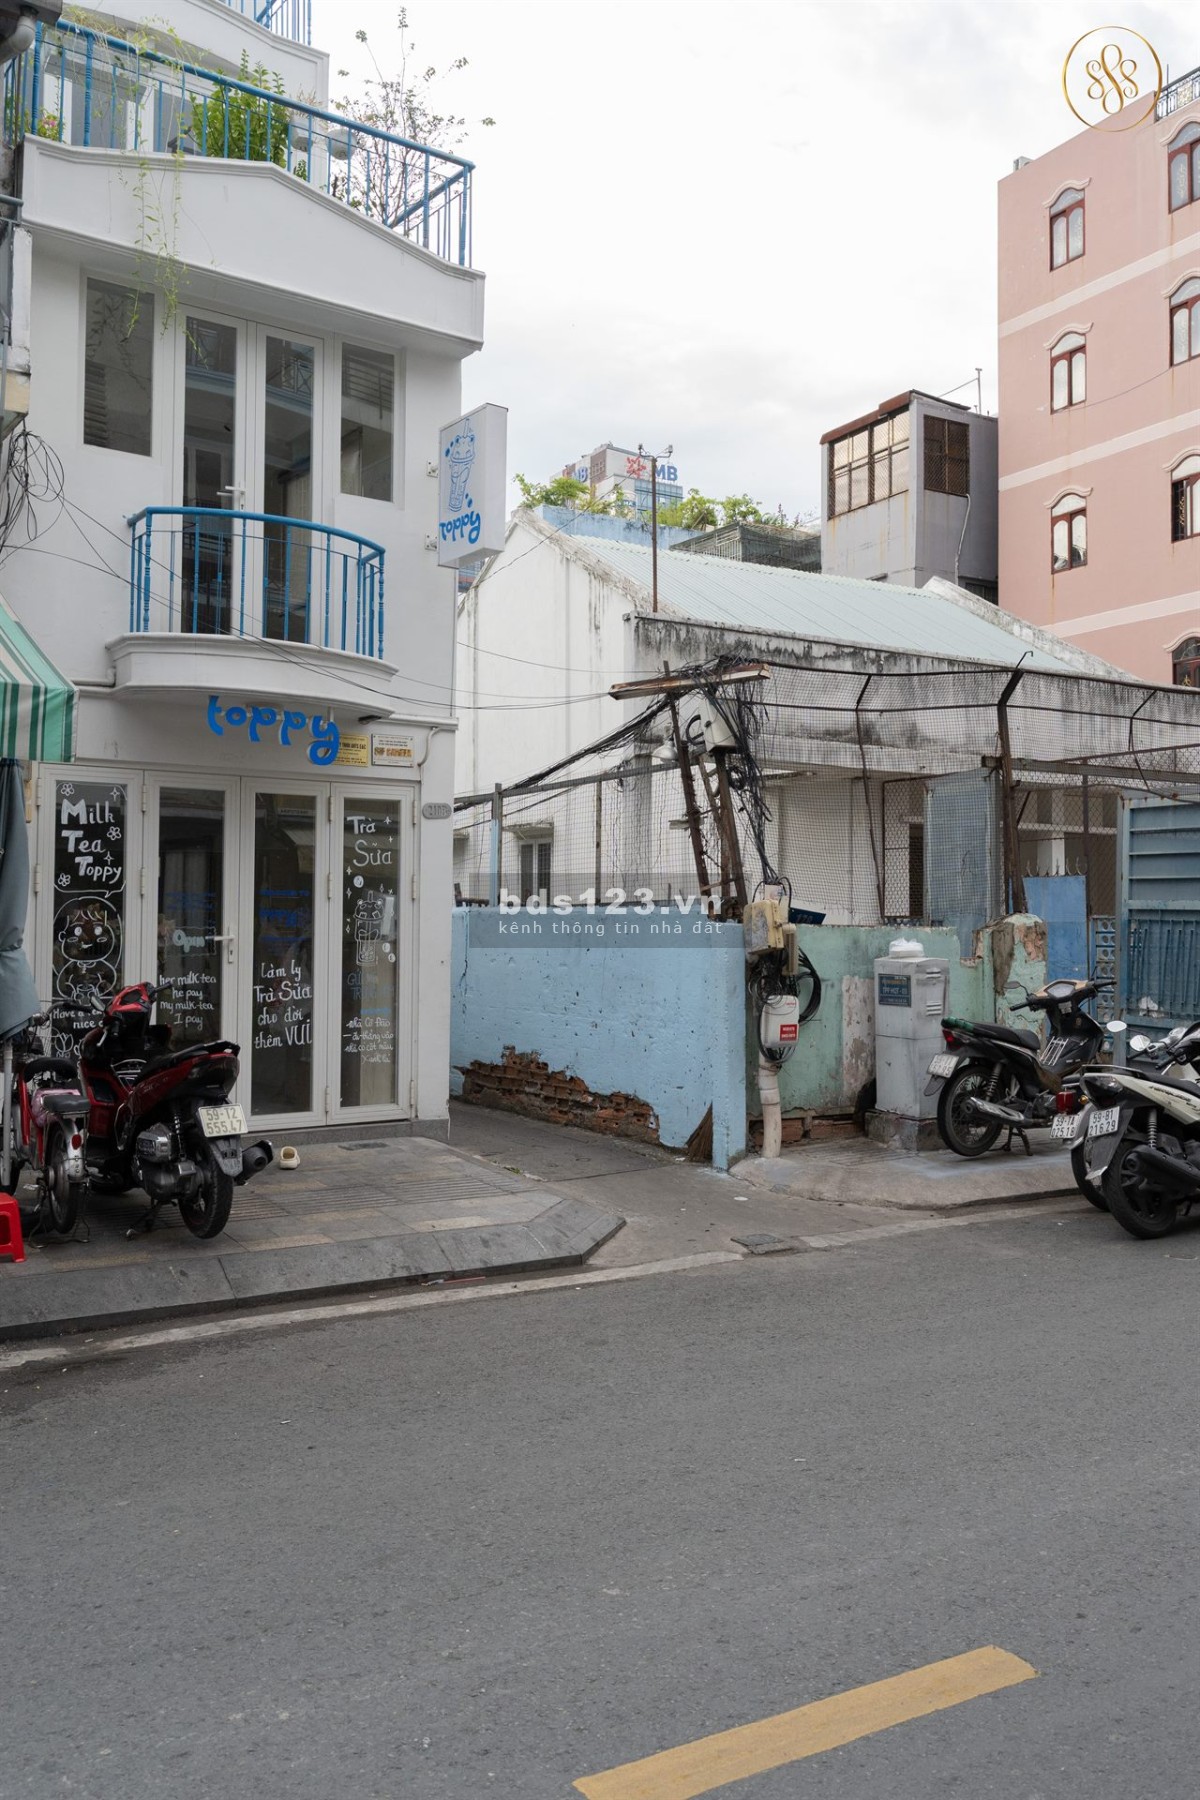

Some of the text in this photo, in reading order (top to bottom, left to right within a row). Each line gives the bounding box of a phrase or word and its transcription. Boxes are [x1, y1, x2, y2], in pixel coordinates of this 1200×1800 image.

[207, 695, 340, 766] toppy
[61, 798, 115, 825] Milk
[346, 816, 376, 835] Trà
[61, 830, 106, 853] Tea
[353, 840, 392, 867] Sữa
[75, 856, 122, 884] Toppy
[172, 929, 205, 953] Open
[253, 985, 276, 1003] Trà
[73, 1020, 96, 1029] nice
[185, 1015, 203, 1030] pay
[257, 1006, 278, 1026] cho
[253, 1031, 283, 1049] thêm
[206, 1107, 238, 1121] 59-T2
